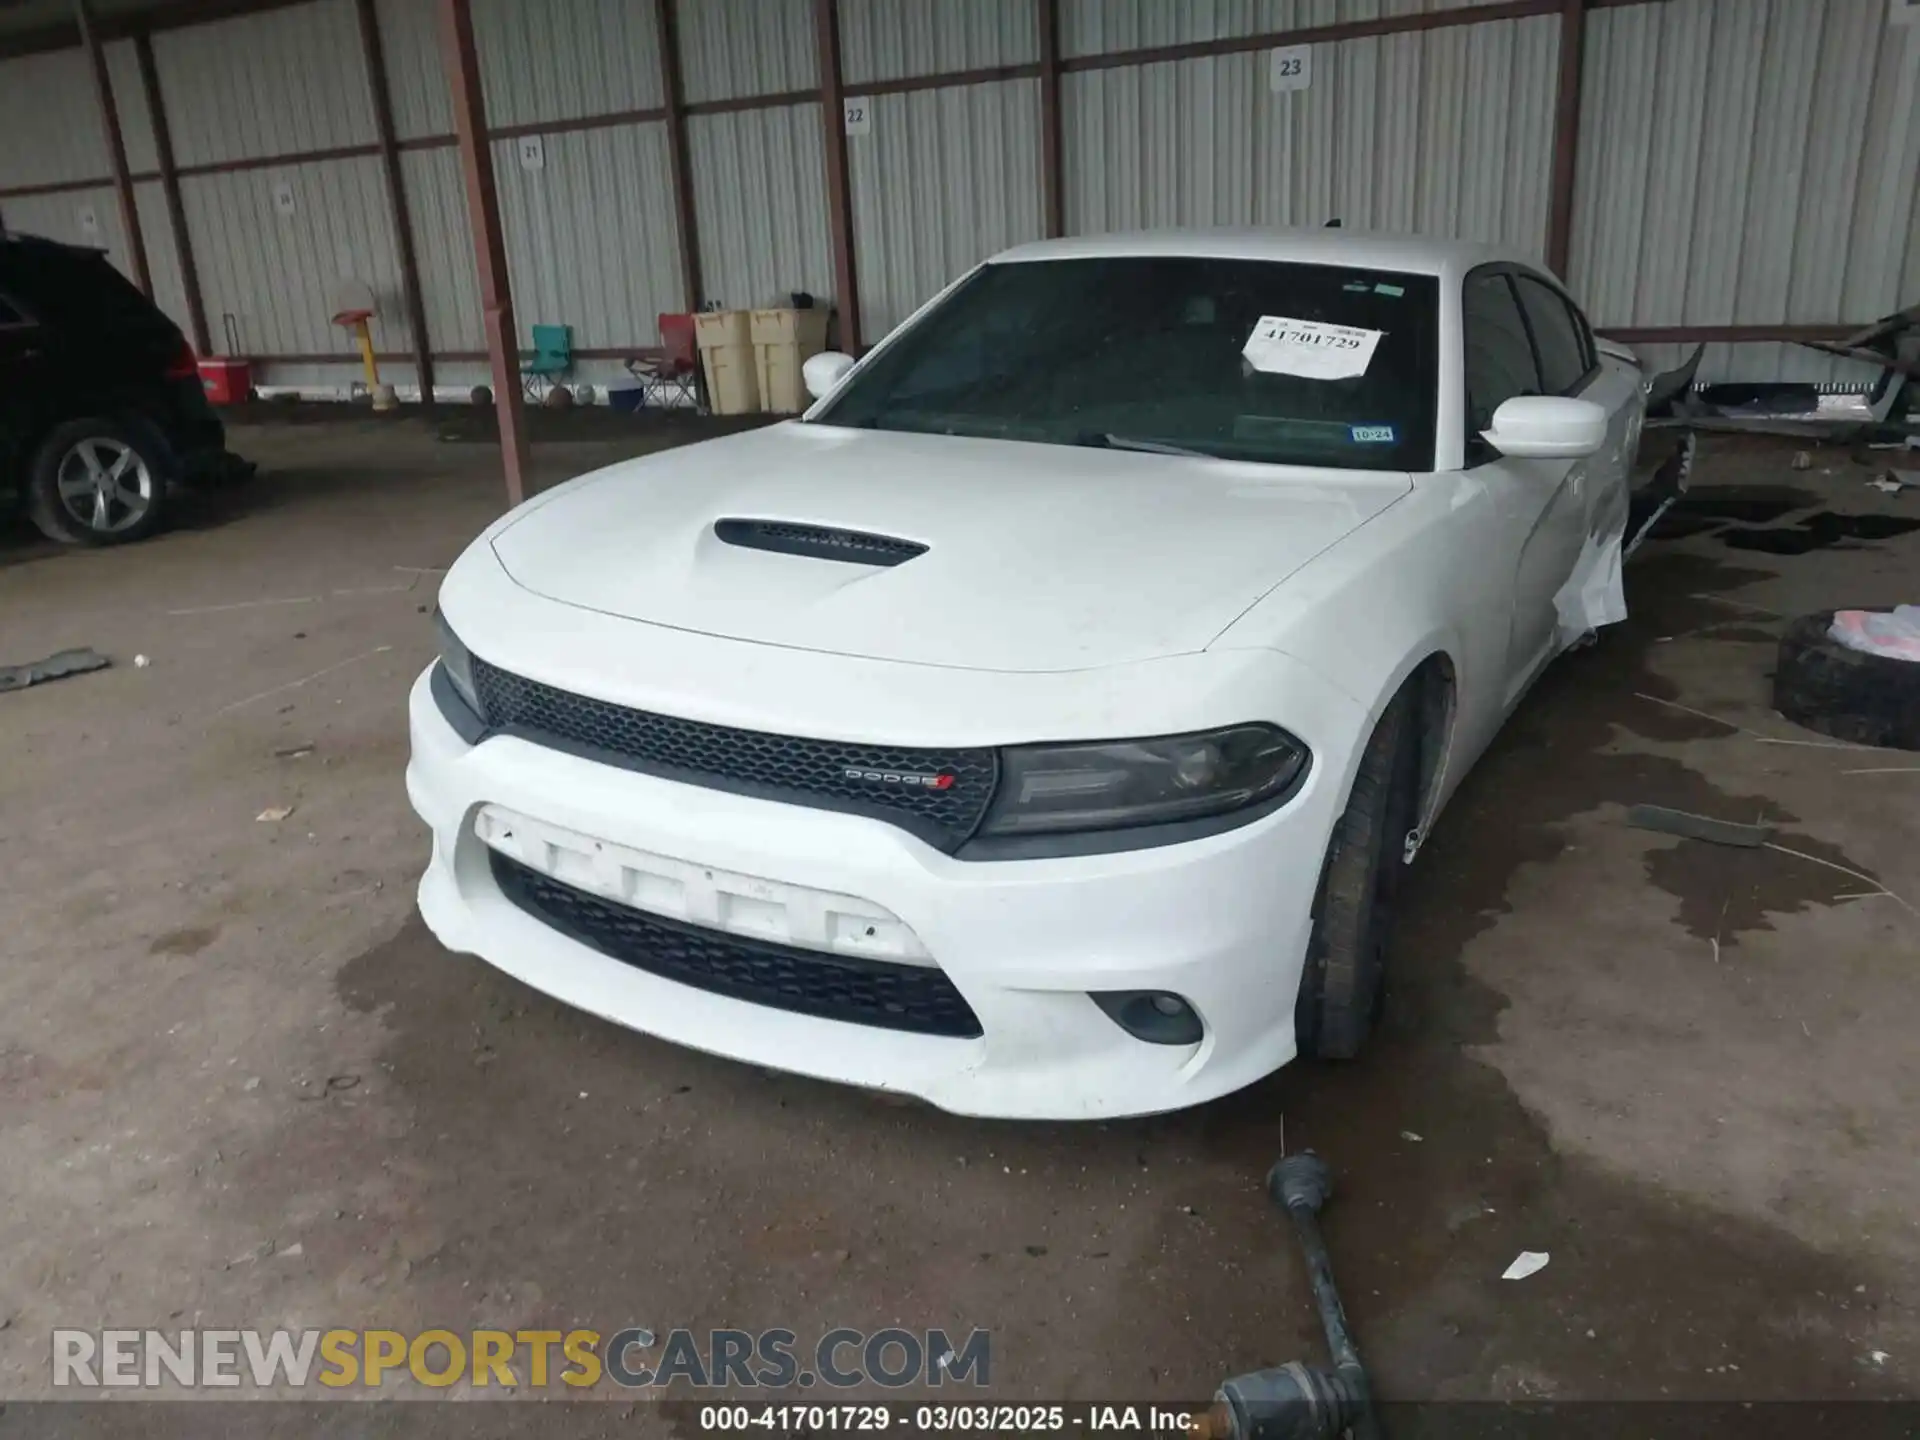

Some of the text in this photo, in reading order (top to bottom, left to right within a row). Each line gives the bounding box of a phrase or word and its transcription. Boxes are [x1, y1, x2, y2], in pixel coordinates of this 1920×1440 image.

[1280, 59, 1302, 77] 23
[847, 109, 864, 123] 22
[1264, 329, 1361, 350] 41701729
[844, 768, 939, 788] DODGE
